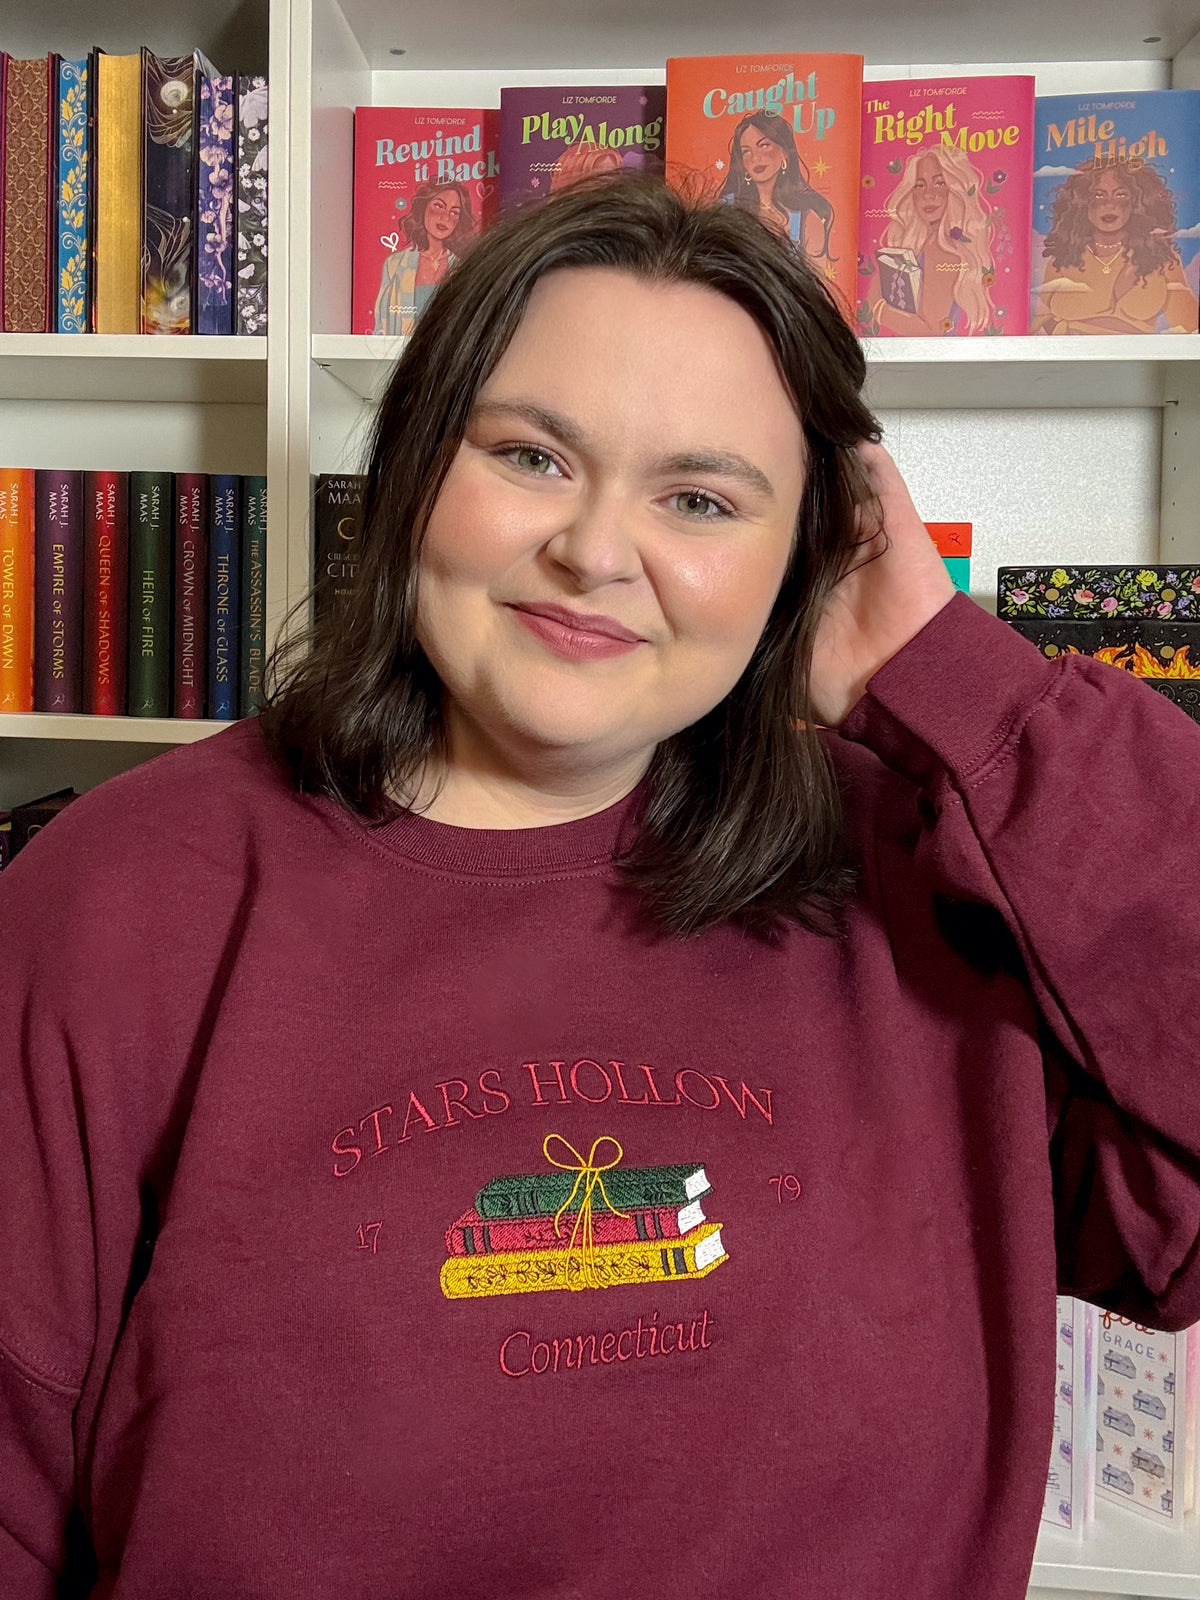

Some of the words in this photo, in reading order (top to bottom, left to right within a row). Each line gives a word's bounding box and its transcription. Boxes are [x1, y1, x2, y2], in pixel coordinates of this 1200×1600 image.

[735, 64, 748, 73] LIZ
[750, 64, 794, 73] TOMFORDE
[562, 95, 574, 104] LIZ
[576, 95, 617, 104] TOMFORDE
[703, 71, 819, 118] Caught
[865, 99, 890, 114] The
[909, 89, 922, 97] LIZ
[924, 87, 967, 97] TOMFORDE
[1078, 104, 1091, 112] LIZ
[1093, 101, 1136, 111] TOMFORDE
[414, 117, 425, 125] LIZ
[427, 116, 466, 126] TOMFORDE
[521, 112, 584, 145] Play
[575, 116, 663, 155] Along
[793, 101, 836, 140] Up
[874, 103, 957, 145] Right
[1046, 114, 1115, 152] Mile
[375, 125, 481, 167] Rewind
[940, 124, 1020, 153] Move
[1092, 130, 1169, 170] High
[414, 163, 429, 182] it
[435, 151, 500, 186] Back
[10, 483, 19, 516] SARAH
[328, 480, 361, 489] SARAH
[328, 492, 361, 504] MAA
[0, 490, 8, 520] MAAS
[48, 491, 58, 521] MAAS
[60, 484, 69, 518] SARAH
[95, 491, 104, 520] MAAS
[107, 483, 116, 518] SARAH
[139, 493, 148, 523] MAAS
[151, 485, 160, 520] SARAH
[179, 494, 188, 525] MAAS
[191, 487, 200, 522] SARAH
[214, 496, 223, 526] MAAS
[225, 488, 234, 523] SARAH
[247, 496, 256, 526] MAAS
[59, 521, 69, 529] J.
[149, 523, 160, 531] J.
[190, 524, 200, 533] J.
[224, 526, 234, 534] J.
[258, 525, 267, 534] J.
[98, 535, 111, 586] QUEEN
[250, 539, 259, 558] THE
[2, 547, 15, 599] TOWER
[53, 544, 65, 596] EMPIRE
[183, 540, 195, 596] CROWN
[327, 563, 360, 578] CIT
[99, 590, 107, 606] OF
[142, 570, 155, 604] HEIR
[217, 553, 229, 616] THRONE
[2, 604, 11, 619] OF
[53, 600, 62, 615] OF
[142, 607, 151, 623] OF
[183, 598, 191, 612] OF
[249, 560, 263, 642] ASSASSIN'S
[141, 626, 154, 657] FIRE
[216, 618, 226, 634] OF
[2, 624, 14, 669] DAWN
[53, 620, 65, 679] STORMS
[98, 610, 111, 685] SHADOWS
[182, 615, 194, 688] MIDNIGHT
[216, 636, 229, 683] GLASS
[248, 648, 261, 694] BLADE
[331, 1070, 511, 1178] STARS
[522, 1059, 774, 1126] HOLLOW
[768, 1173, 802, 1204] 79
[355, 1221, 383, 1254] 17
[499, 1310, 714, 1378] Connecticut
[1103, 1331, 1156, 1360] GRACE
